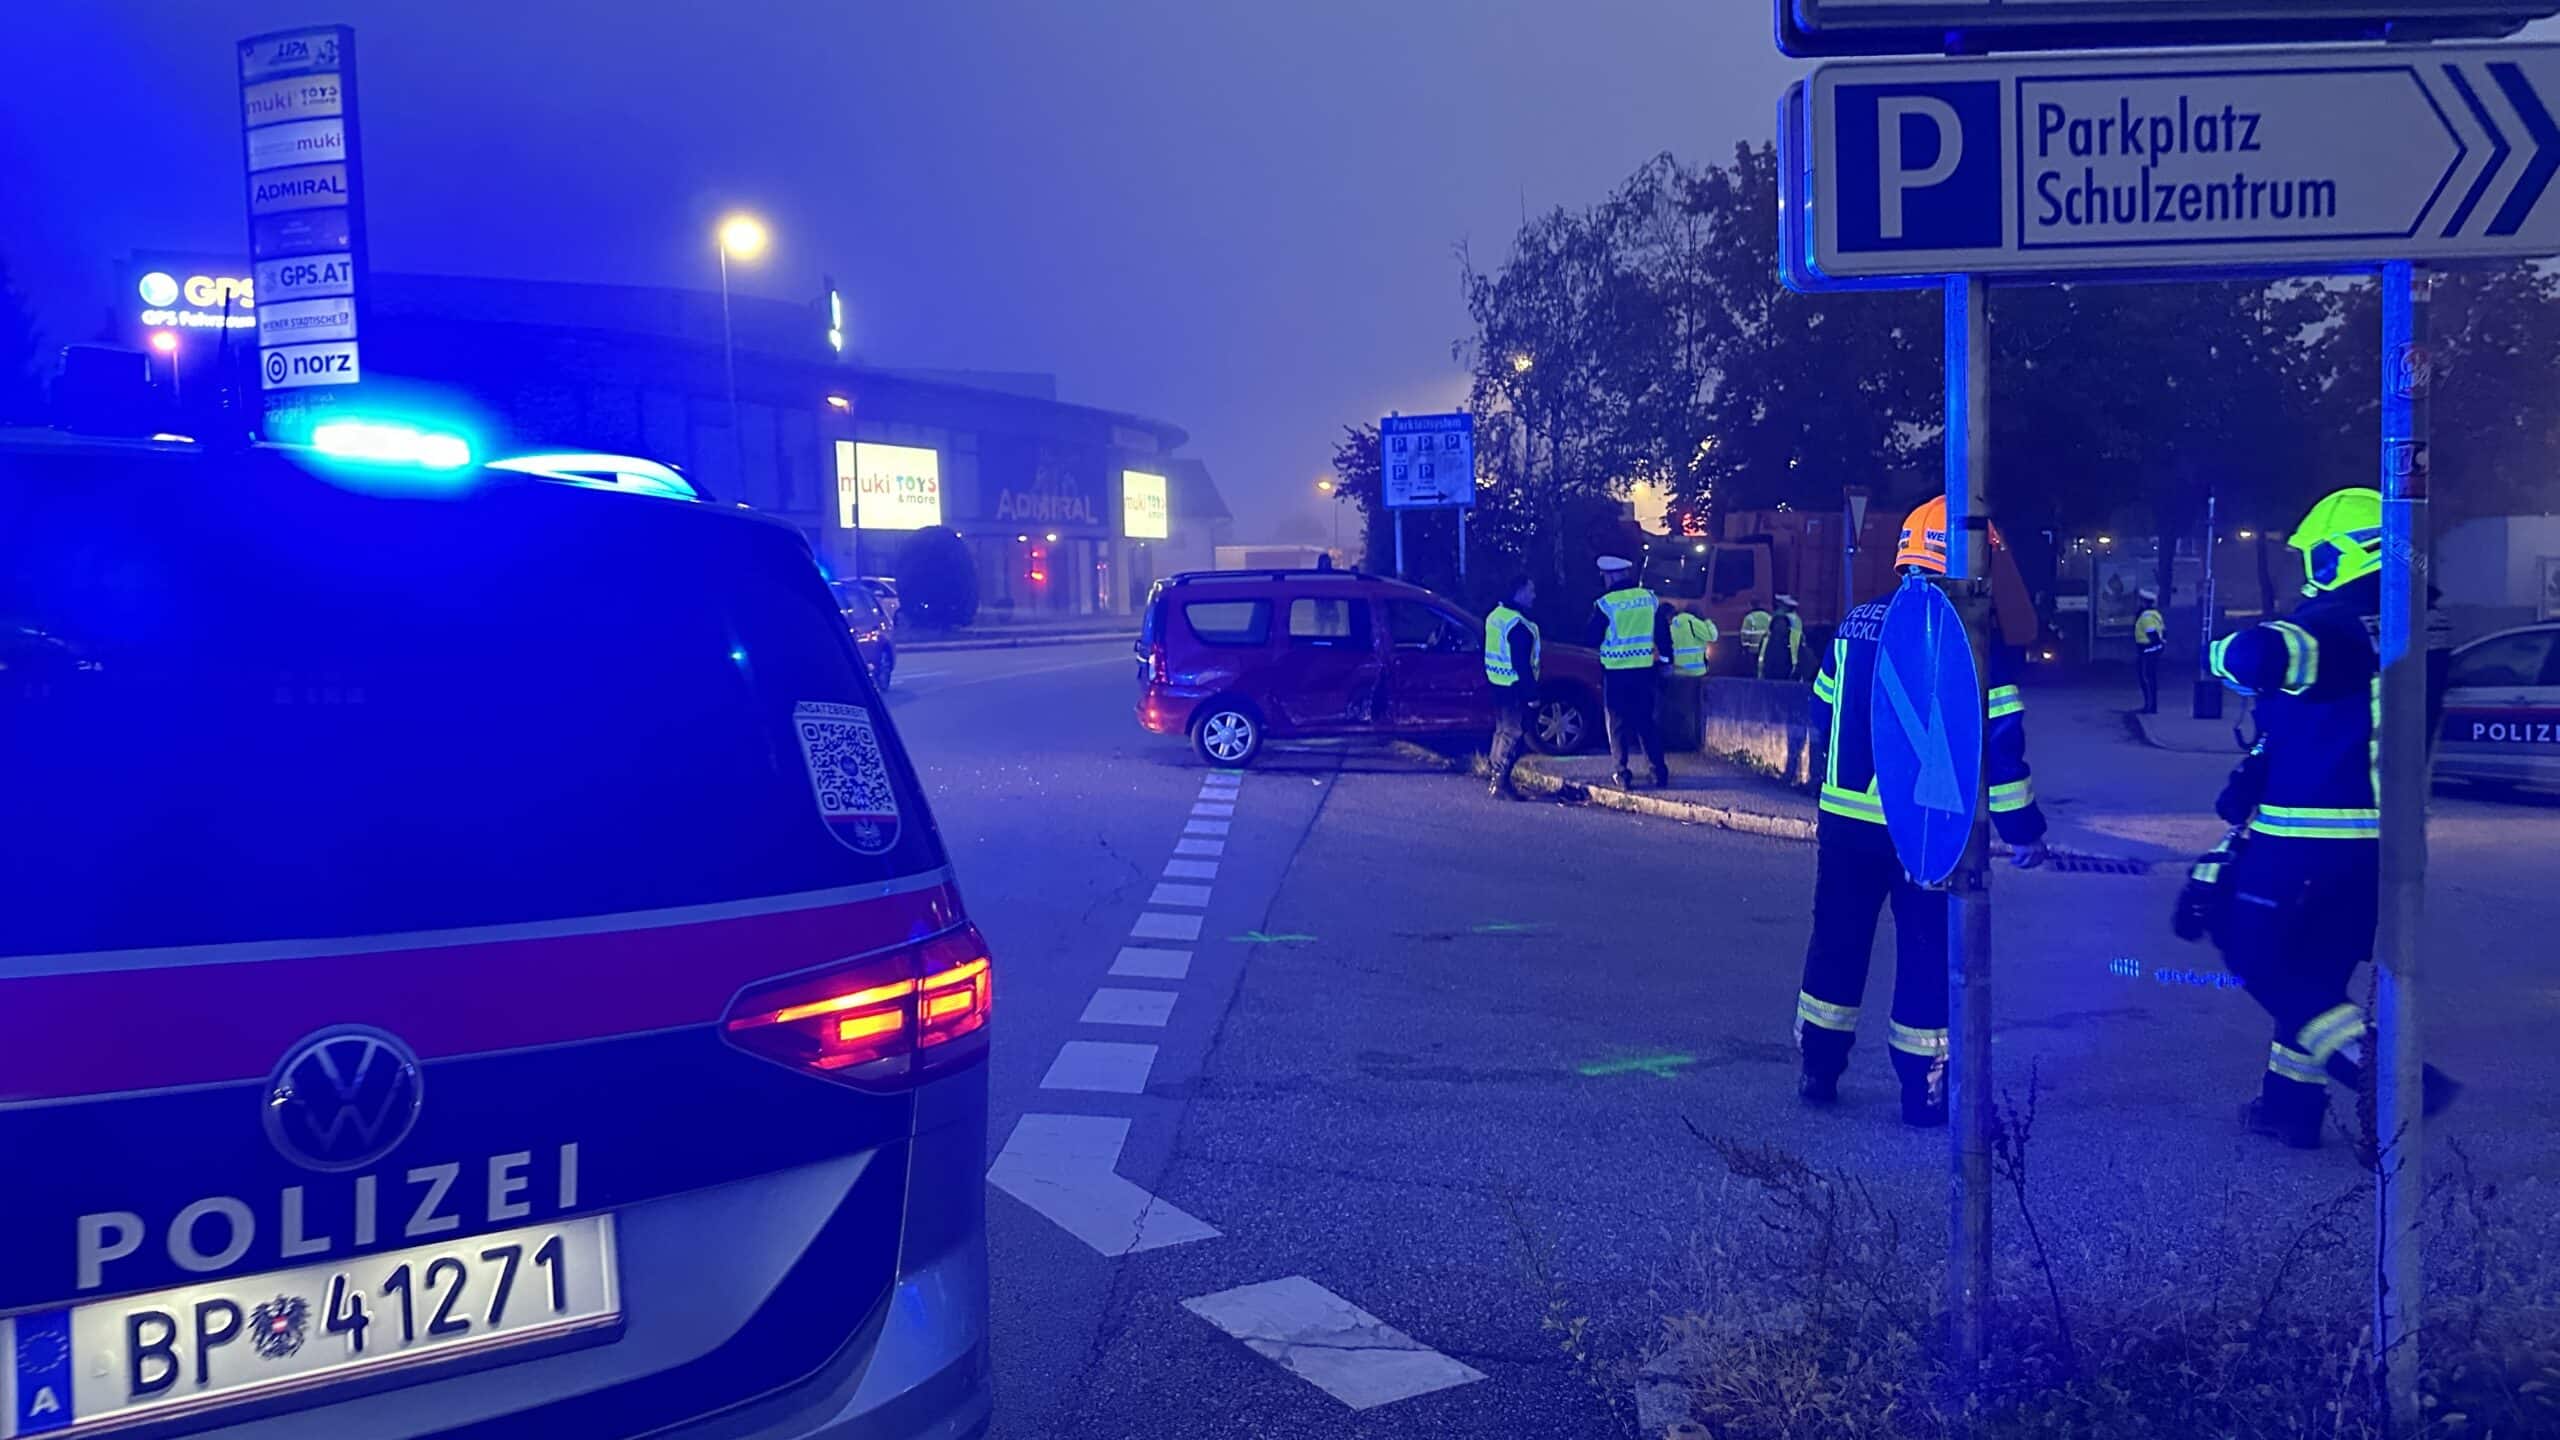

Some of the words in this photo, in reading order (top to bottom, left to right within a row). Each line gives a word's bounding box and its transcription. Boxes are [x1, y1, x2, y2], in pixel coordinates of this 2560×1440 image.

[247, 92, 292, 115] muki
[297, 133, 341, 151] muki
[2037, 97, 2263, 168] Parkplatz
[1877, 95, 1963, 240] P
[255, 176, 347, 203] ADMIRAL
[2037, 165, 2337, 227] Schulzentrum
[281, 262, 350, 287] GPS.AT
[294, 354, 351, 374] norz
[841, 472, 890, 494] muki
[907, 495, 937, 505] more
[996, 488, 1099, 524] ADMIRAL
[75, 1142, 579, 1290] POLIZEI
[126, 1295, 244, 1398] BP
[323, 1233, 567, 1352] 41271
[29, 1384, 61, 1418] A
